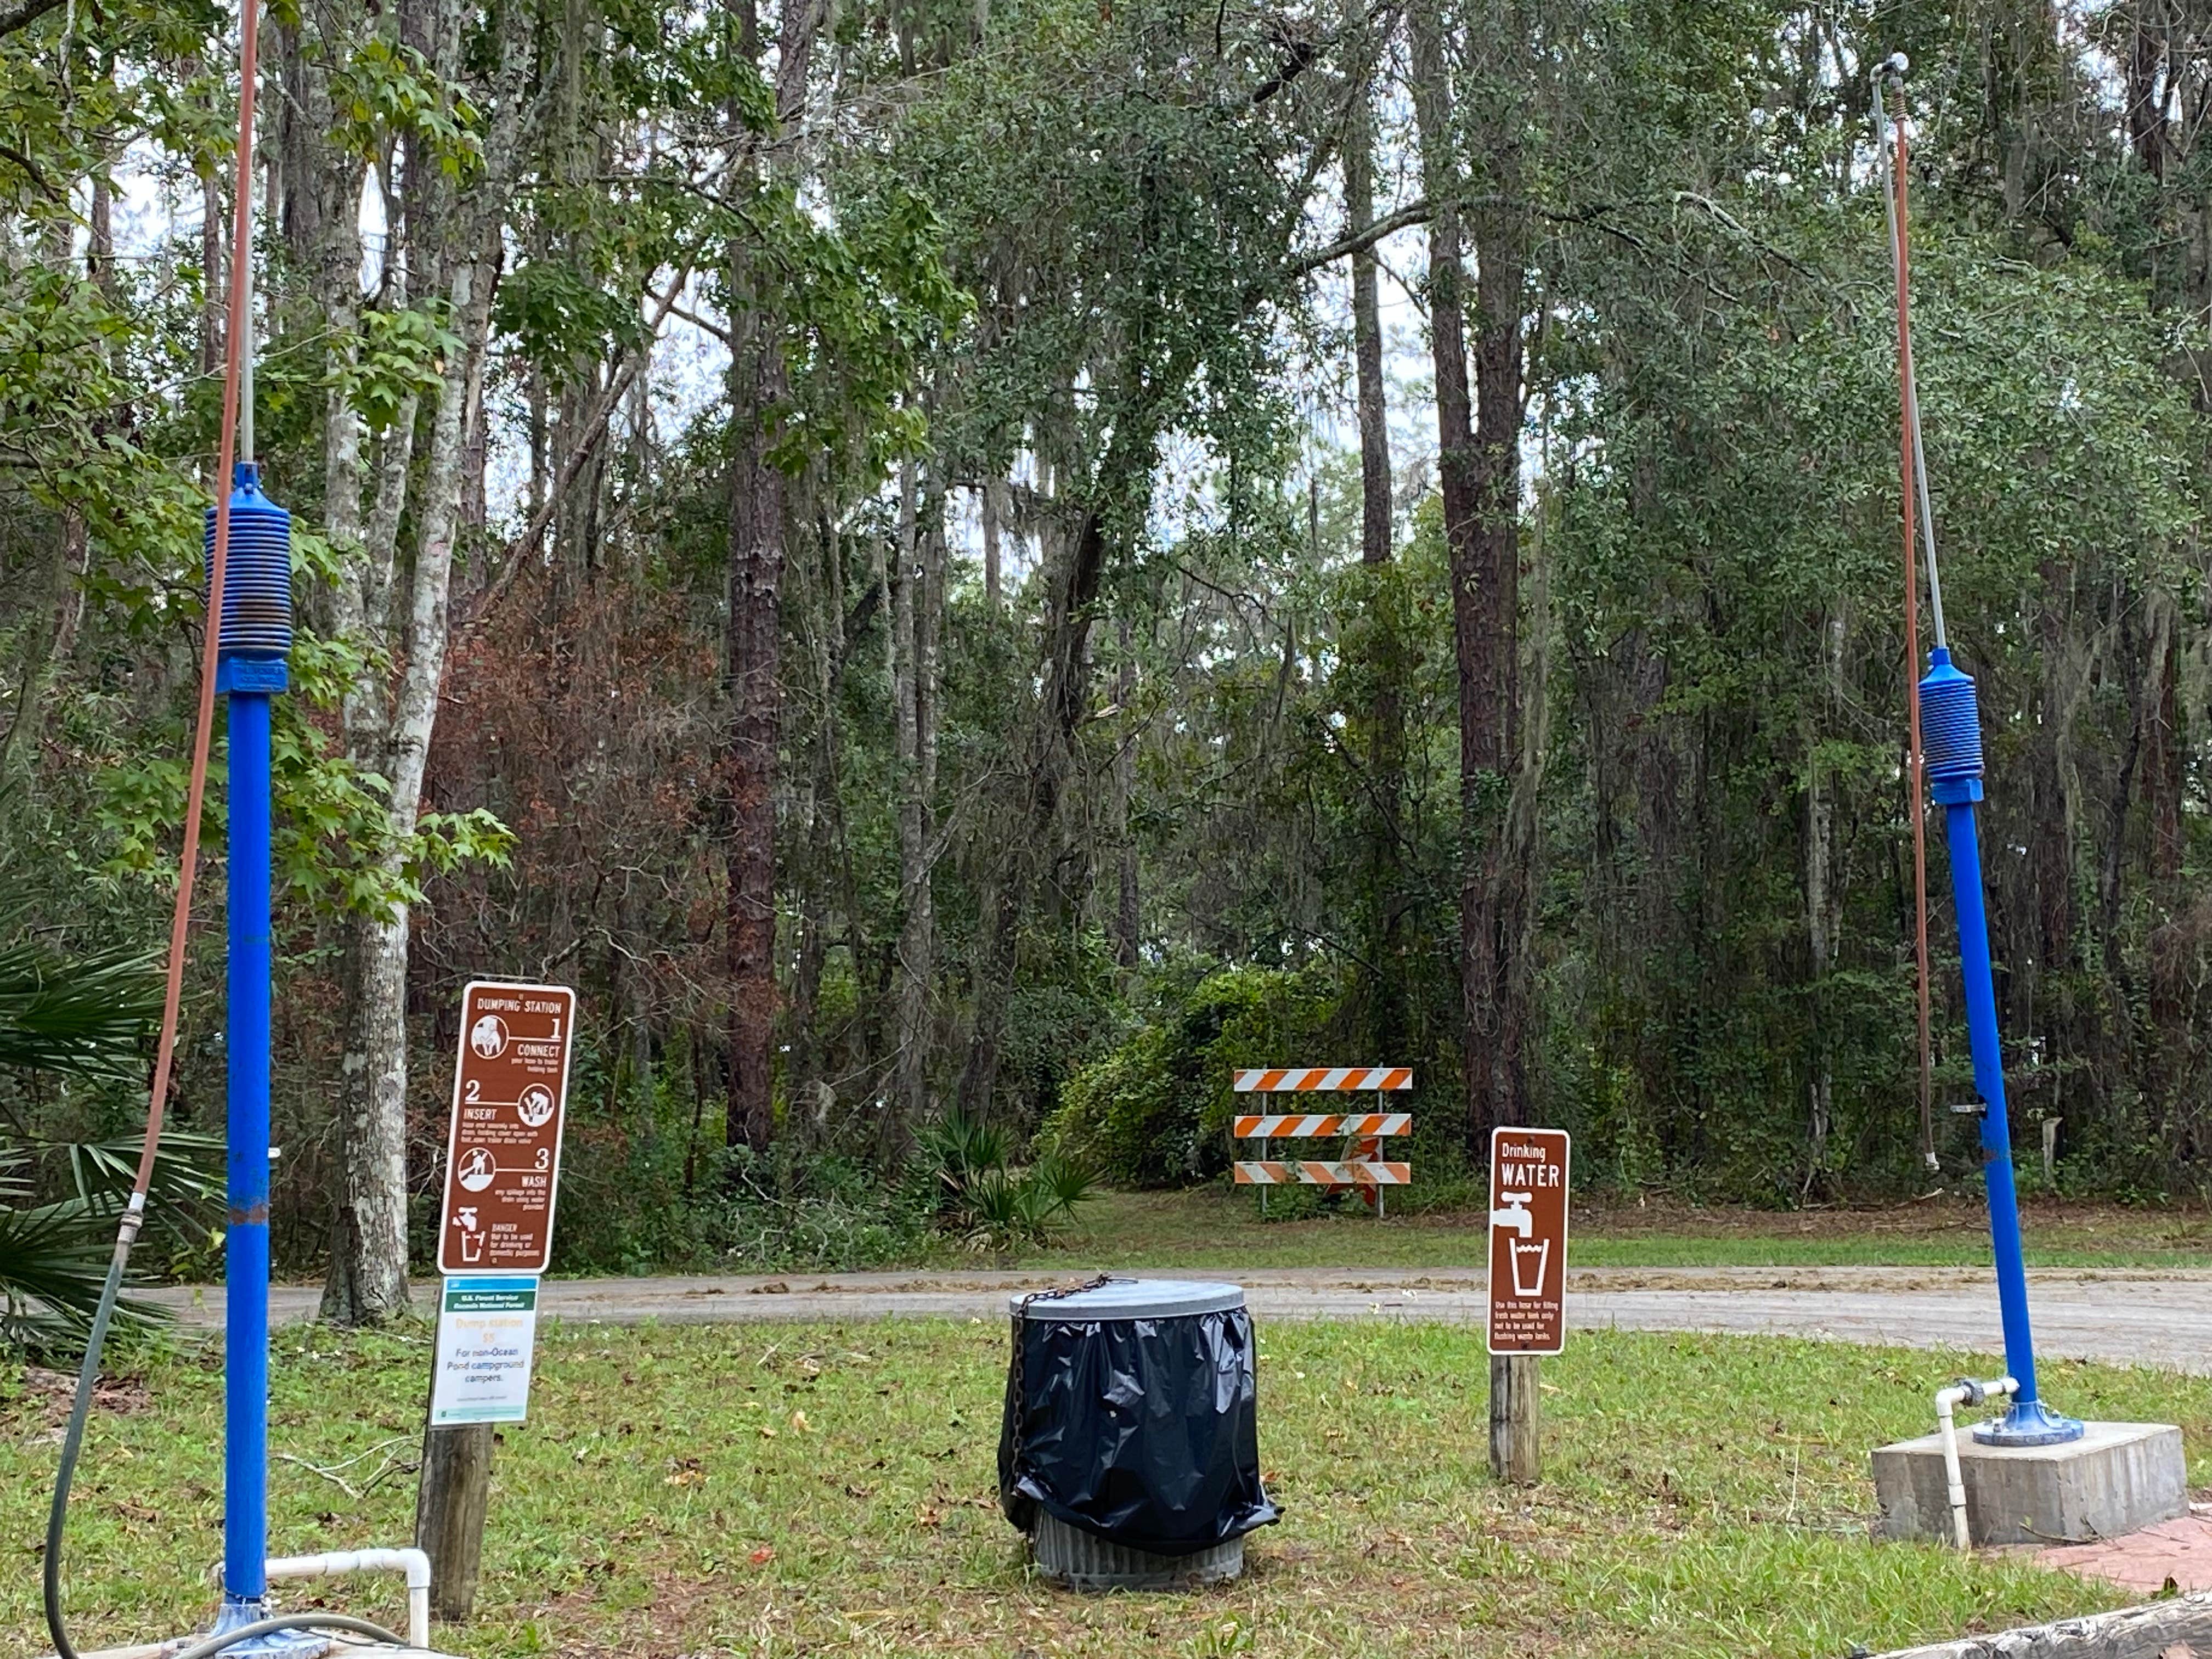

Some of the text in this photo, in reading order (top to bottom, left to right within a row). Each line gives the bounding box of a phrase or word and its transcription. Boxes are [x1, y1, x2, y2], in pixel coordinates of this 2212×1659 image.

[477, 998, 561, 1013] DUMPING STATION
[551, 1019, 561, 1039] 1
[518, 1044, 560, 1057] CONNECT
[465, 1080, 480, 1101] 2
[464, 1109, 497, 1120] INSERT
[535, 1148, 549, 1169] 3
[1502, 1142, 1545, 1163] Drinking
[522, 1176, 546, 1187] WASH
[1501, 1163, 1559, 1187] WATER
[456, 1318, 486, 1329] Dump
[456, 1347, 518, 1357] For non-Ocean
[447, 1359, 524, 1370] Pond campground
[466, 1375, 504, 1383] campers.
